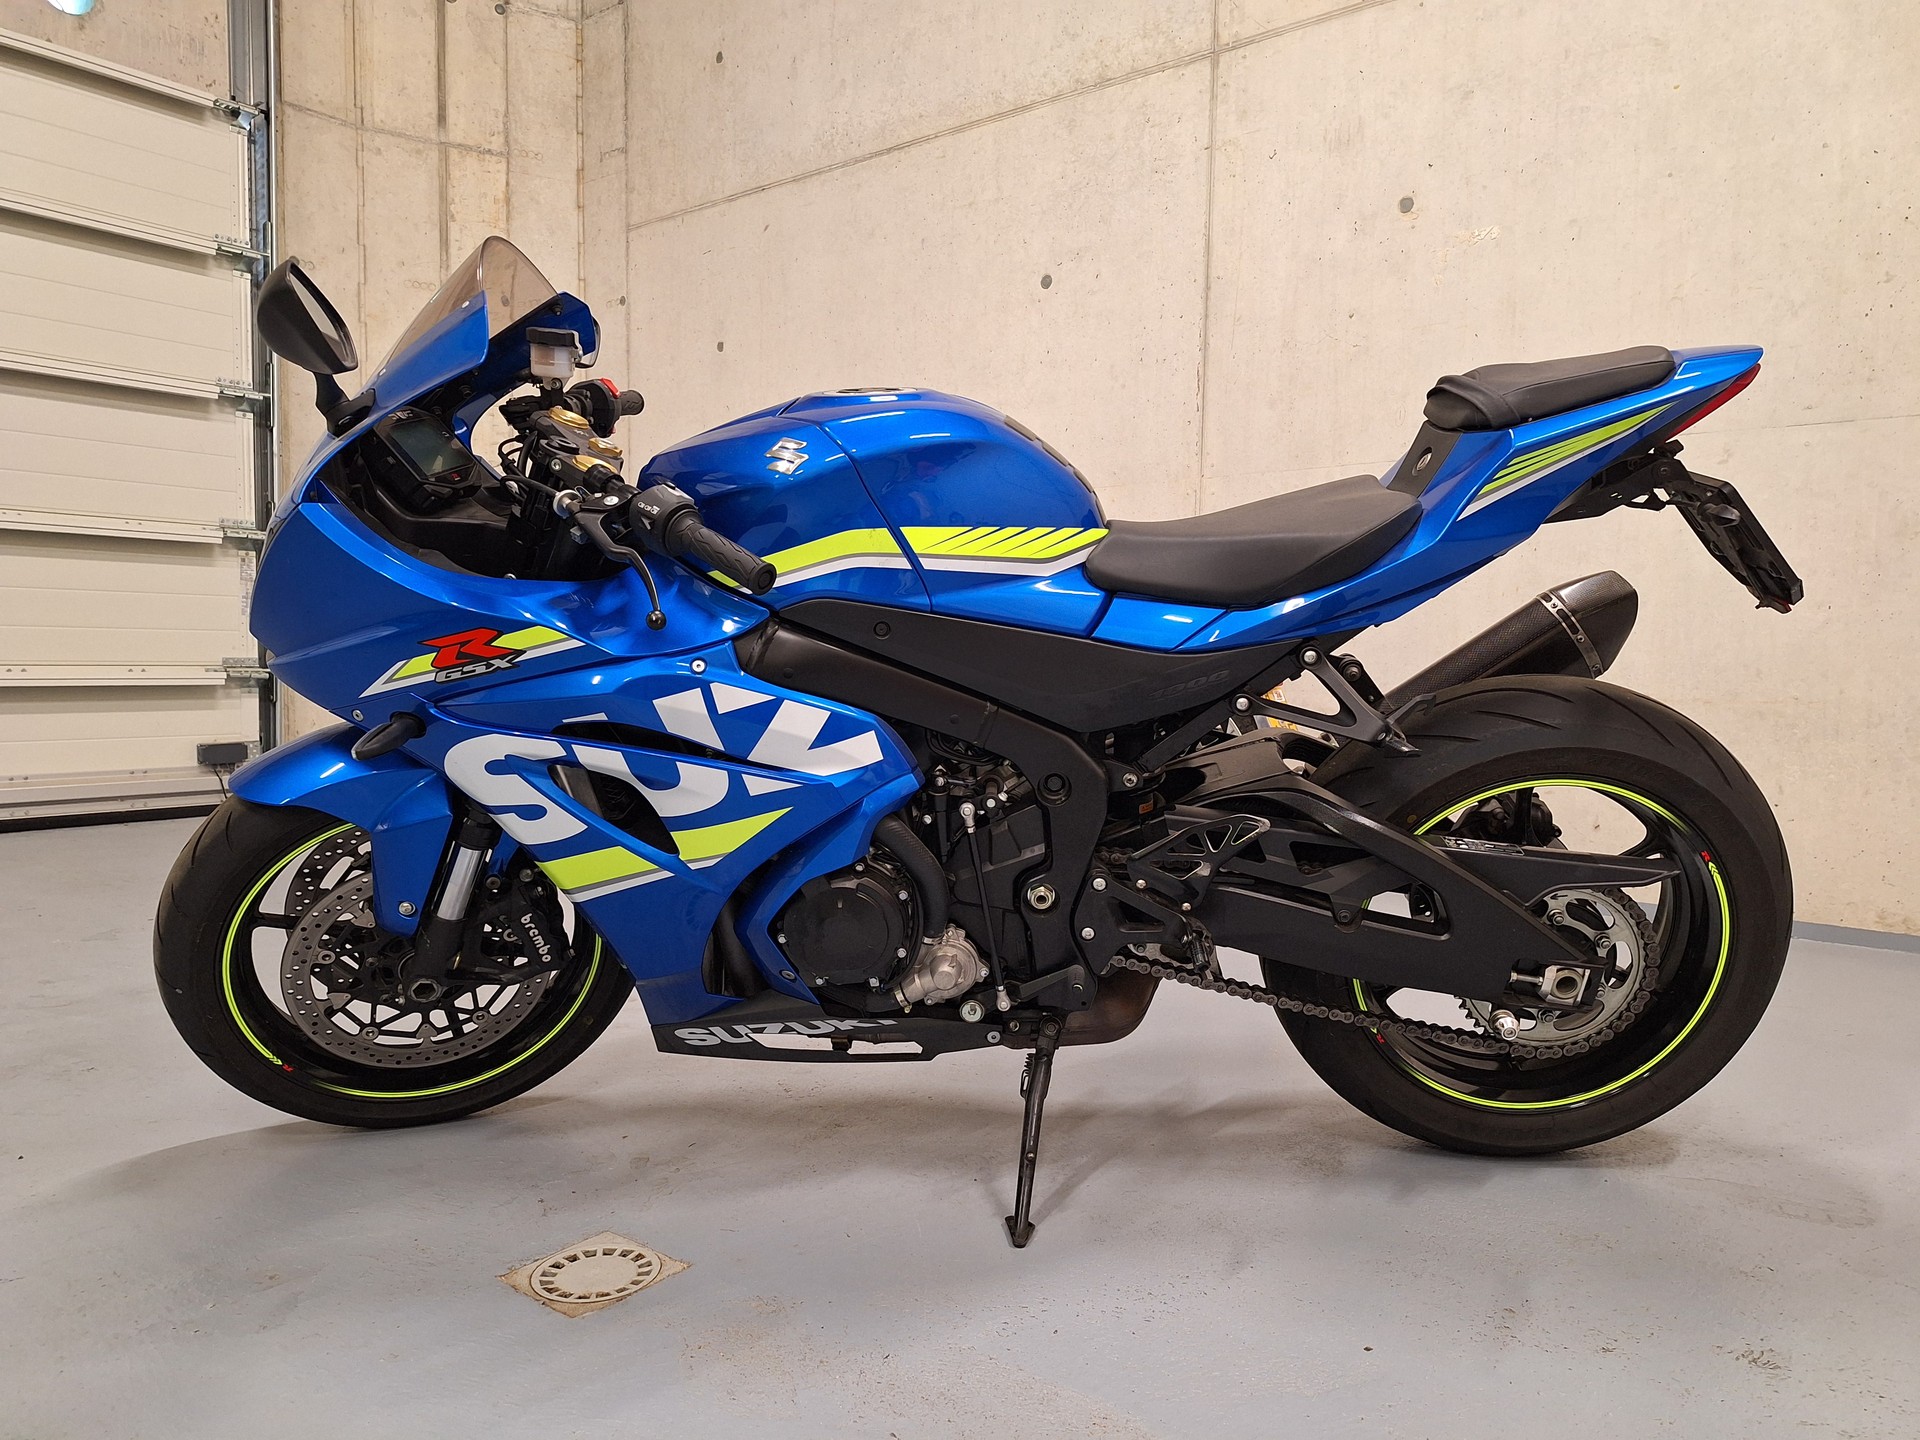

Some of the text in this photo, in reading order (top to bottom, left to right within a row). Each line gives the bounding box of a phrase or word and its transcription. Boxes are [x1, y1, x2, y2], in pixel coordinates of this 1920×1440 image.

[422, 630, 513, 668] R
[435, 655, 515, 683] GSX
[520, 913, 551, 962] brembo
[674, 1019, 898, 1046] SUZUK
